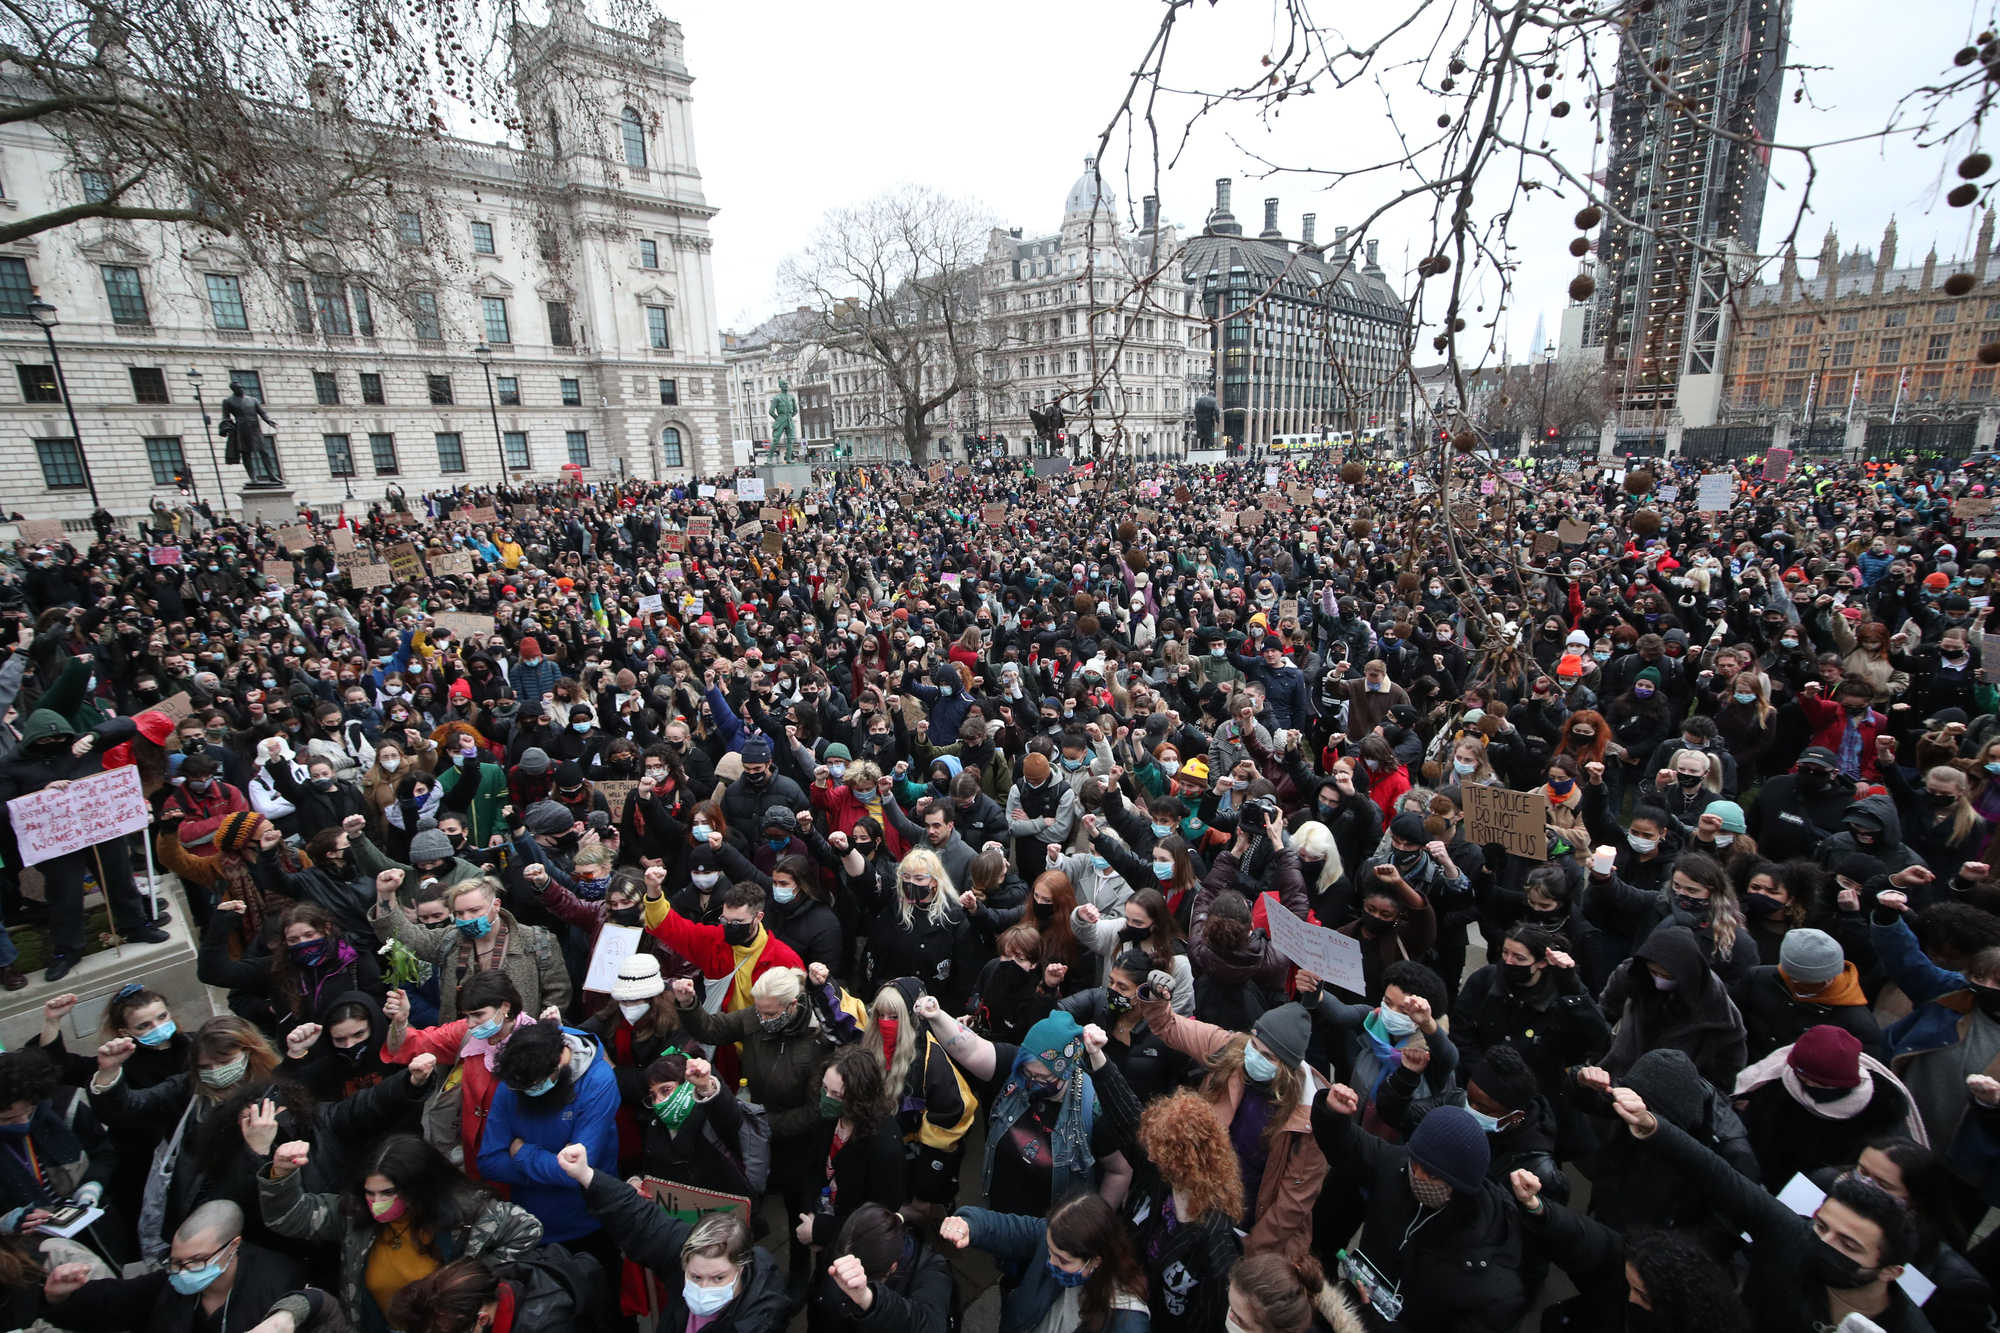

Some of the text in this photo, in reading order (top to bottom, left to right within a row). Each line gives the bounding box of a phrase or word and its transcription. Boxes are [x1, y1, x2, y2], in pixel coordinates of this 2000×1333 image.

[665, 535, 679, 543] SAFE
[338, 551, 357, 560] MET
[394, 558, 412, 567] OUR
[434, 553, 471, 574] ACAB
[396, 564, 420, 578] FAULT
[1282, 601, 1296, 609] KILL
[444, 614, 480, 627] GIRLS
[602, 782, 638, 790] THE POLIC
[1465, 786, 1530, 814] THE POLICE
[1475, 806, 1518, 830] DO NOT
[62, 828, 122, 852] PAT PARKER
[1519, 833, 1536, 856] US
[656, 1190, 678, 1215] Ni
